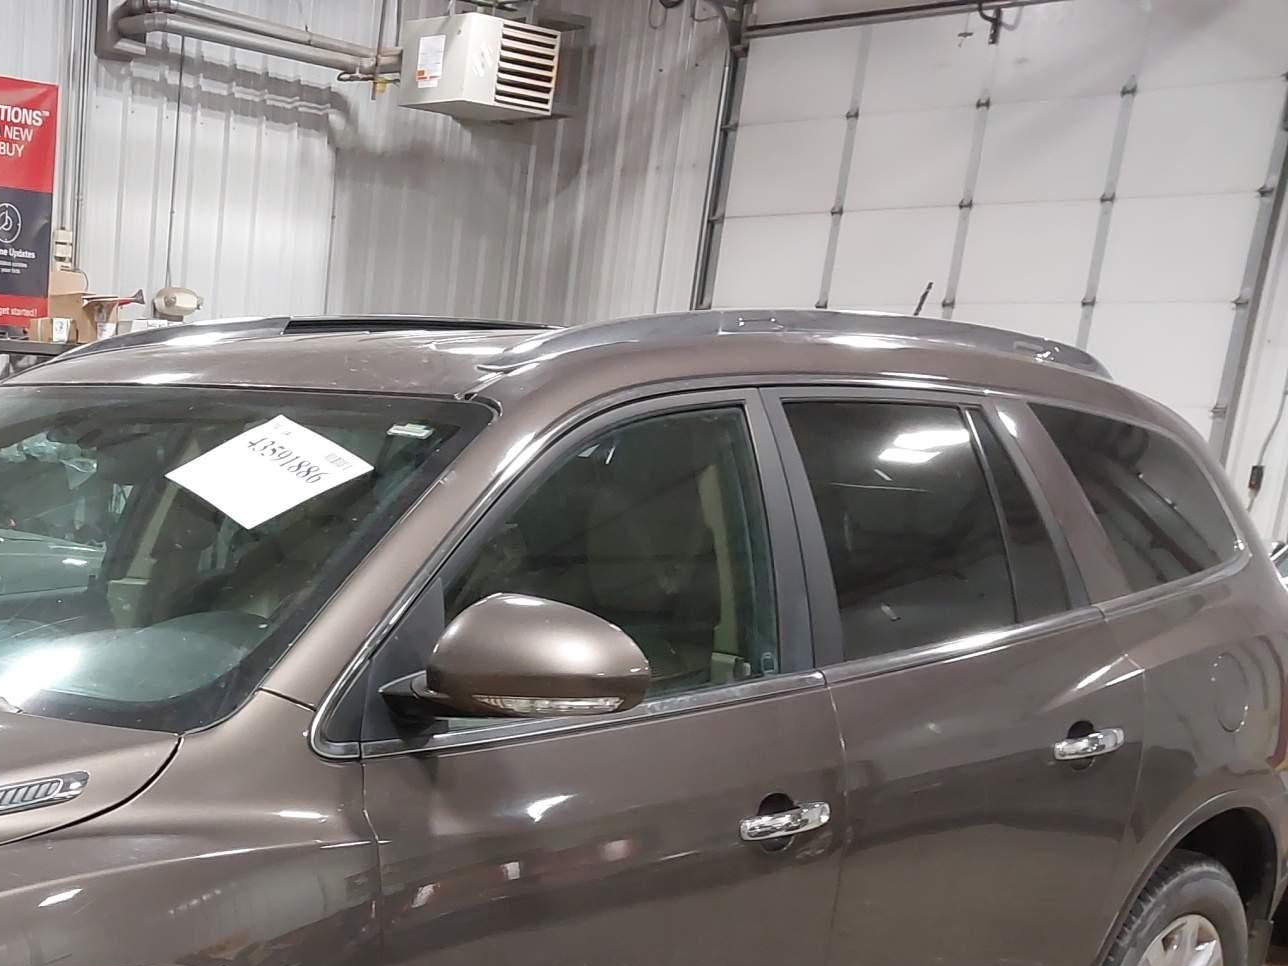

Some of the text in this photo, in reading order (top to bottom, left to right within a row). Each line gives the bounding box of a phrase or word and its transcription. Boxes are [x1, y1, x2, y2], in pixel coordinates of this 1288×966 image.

[3, 127, 34, 142] NEW
[8, 247, 36, 259] Updates
[247, 437, 329, 484] 43591886
